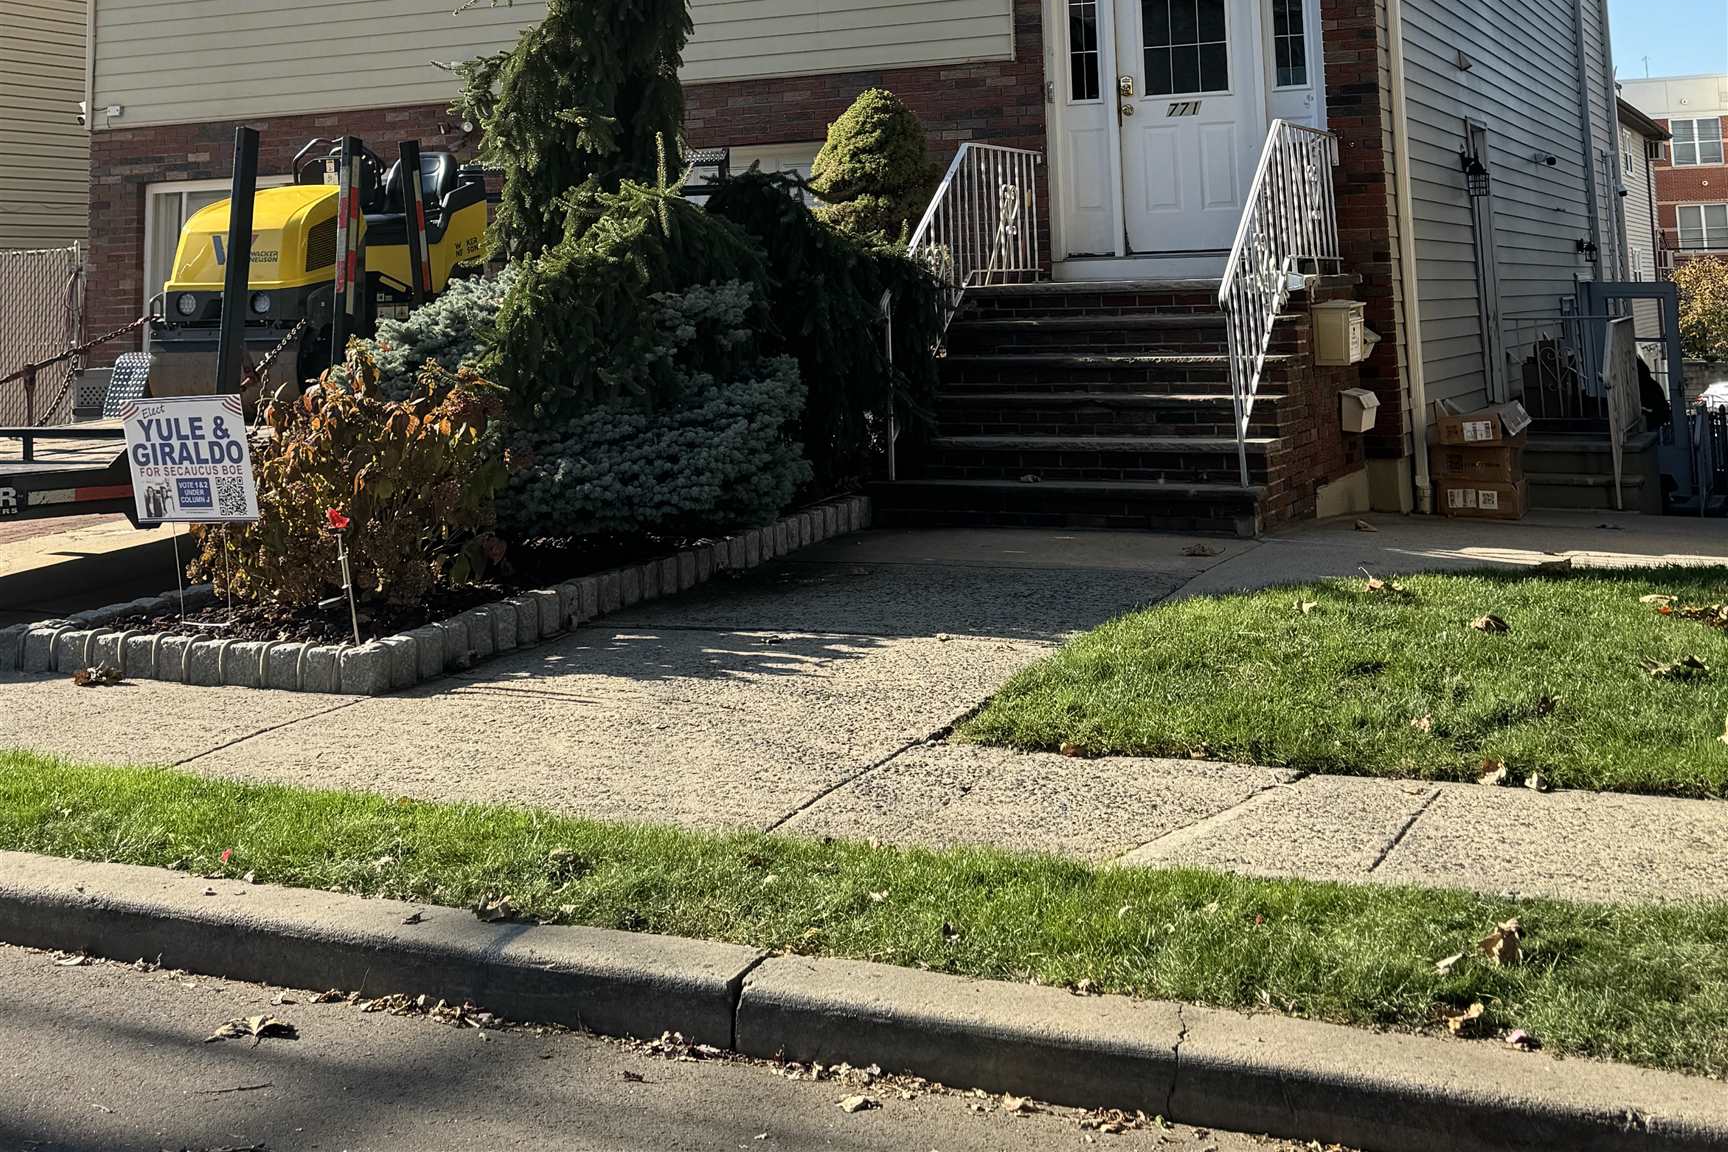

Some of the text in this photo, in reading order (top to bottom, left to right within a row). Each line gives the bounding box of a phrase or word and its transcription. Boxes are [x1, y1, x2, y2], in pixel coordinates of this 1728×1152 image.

[1168, 102, 1199, 117] 771
[141, 404, 166, 420] Elect
[136, 415, 231, 443] YULE &
[132, 439, 244, 467] GIRALDO
[139, 465, 243, 478] FOR SECAUCUS BOE
[178, 481, 194, 489] VOTE
[184, 488, 205, 496] UNDER
[180, 495, 206, 503] COLUMN
